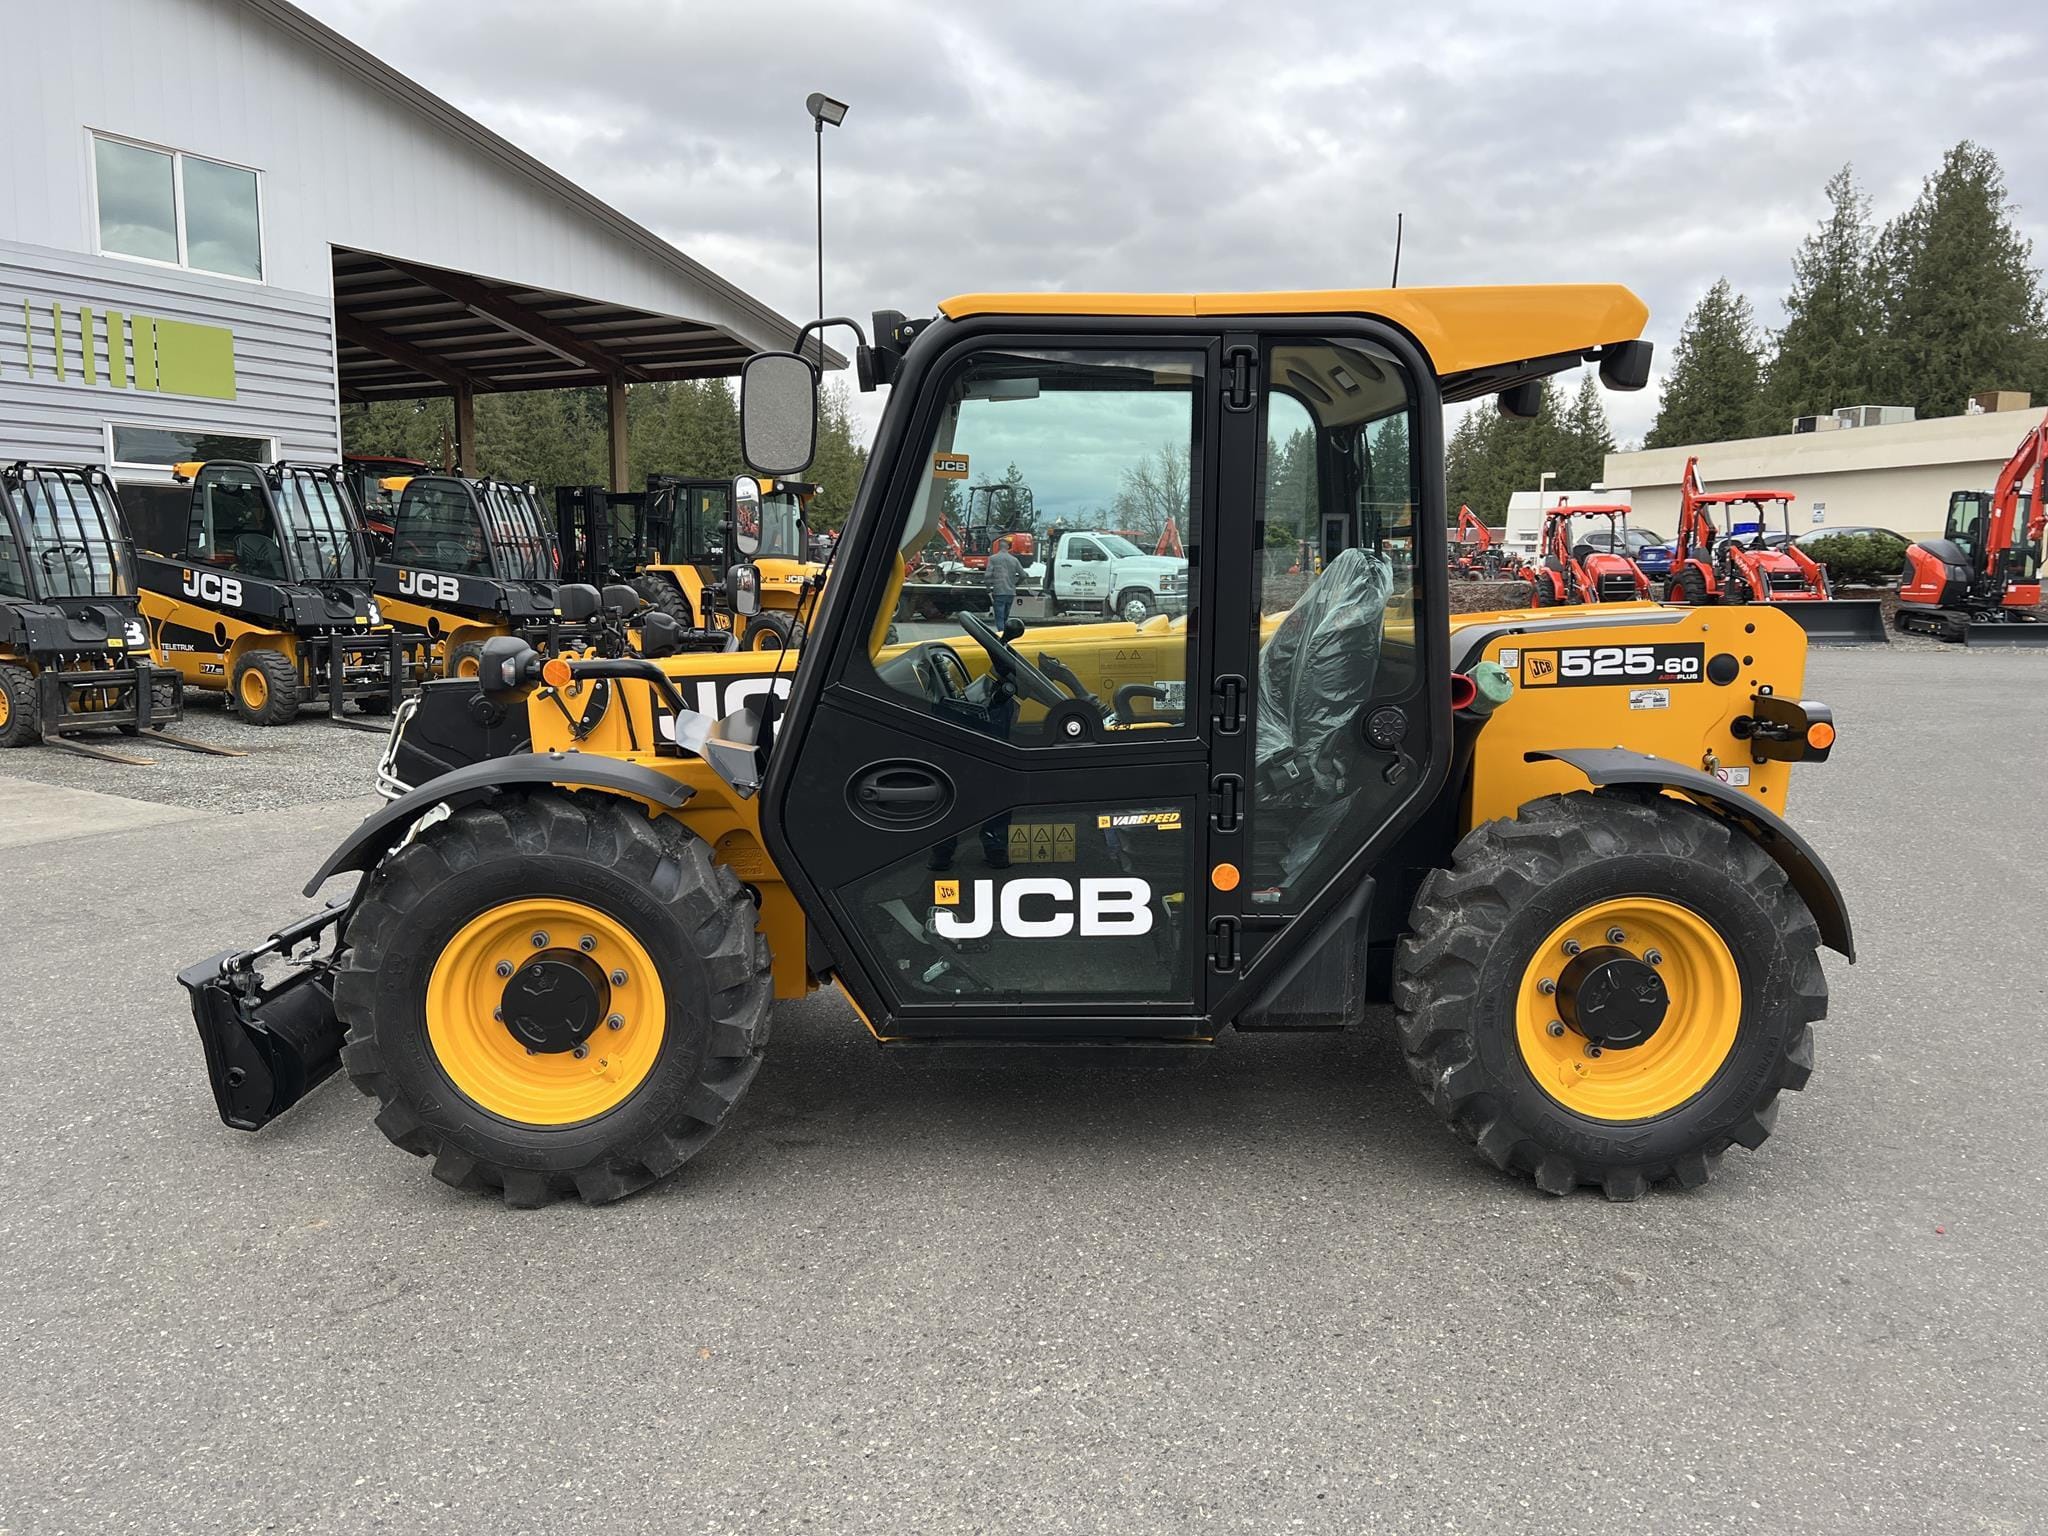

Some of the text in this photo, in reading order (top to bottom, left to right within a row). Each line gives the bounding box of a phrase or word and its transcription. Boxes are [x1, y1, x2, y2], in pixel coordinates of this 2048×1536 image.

[936, 461, 967, 471] JCB
[183, 571, 243, 607] JCB
[399, 571, 460, 602] JCB
[715, 613, 732, 630] JCB
[161, 643, 195, 651] TELETRUK
[1533, 659, 1552, 676] JCB
[1560, 647, 1699, 677] 525-60
[940, 885, 955, 899] JCB
[935, 878, 1153, 939] JCB
